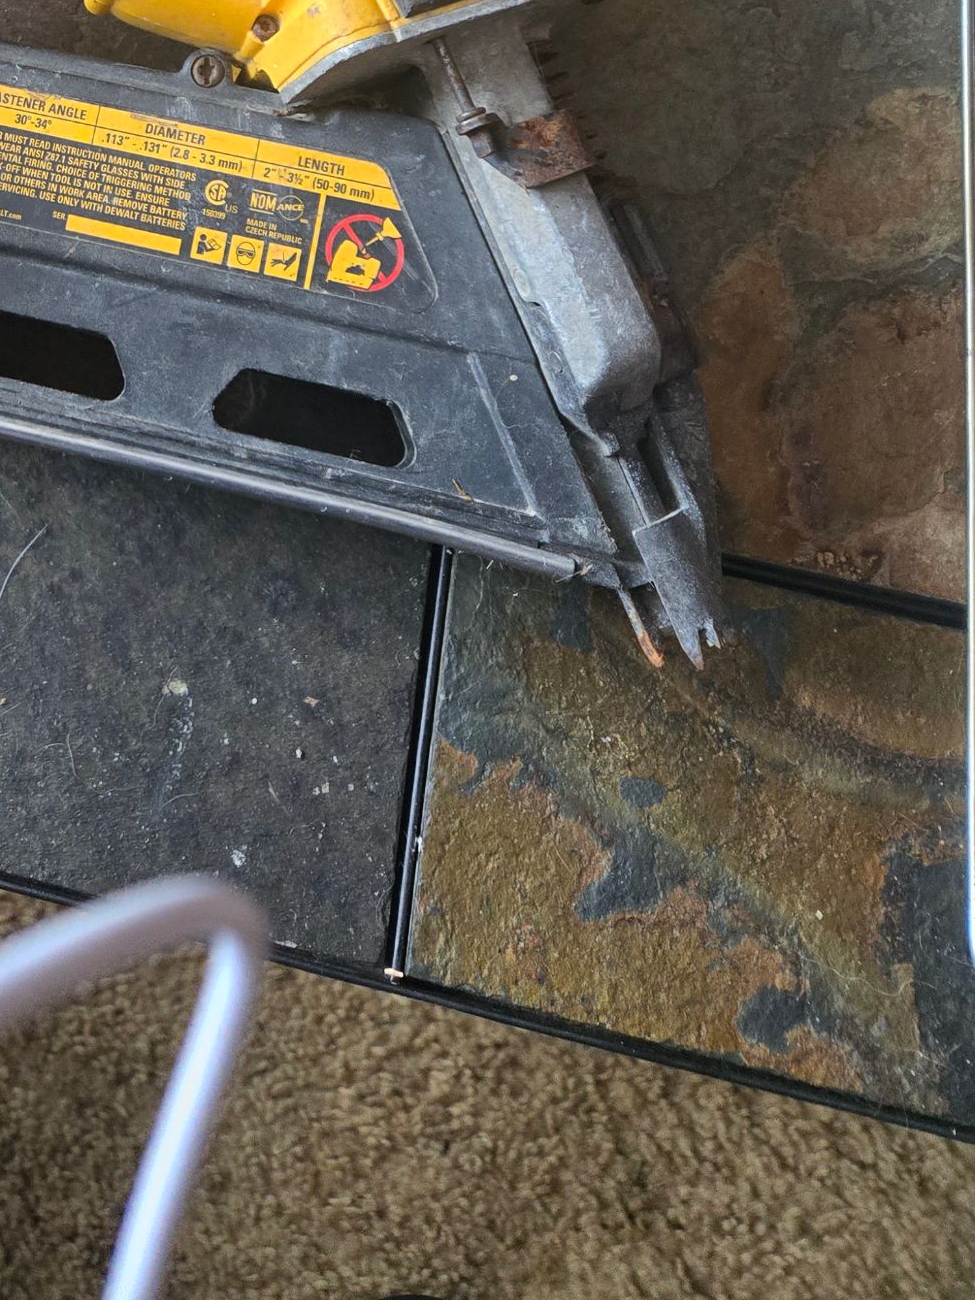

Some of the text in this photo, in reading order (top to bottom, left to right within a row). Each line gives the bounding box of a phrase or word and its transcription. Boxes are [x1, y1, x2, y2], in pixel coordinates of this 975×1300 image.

[48, 103, 87, 120] ANGLE
[145, 123, 206, 146] DIAMETER
[3, 133, 28, 145] MUST
[29, 138, 51, 149] READ
[52, 143, 107, 161] INSTRUCTION
[148, 164, 197, 181] OPERATORS
[22, 147, 44, 158] ANSI
[67, 156, 99, 170] SAFETY
[100, 163, 139, 179] GLASSES
[140, 172, 164, 184] WITH
[165, 177, 186, 189] SIDE
[199, 153, 216, 165] 3.3
[298, 157, 346, 175] LENGTH
[24, 157, 55, 171] FIRING.
[56, 164, 87, 177] CHOICE
[88, 171, 101, 181] OF
[101, 174, 153, 192] TRIGGERING
[0, 173, 13, 182] OR
[13, 175, 46, 189] OTHERS
[47, 183, 57, 192] IN
[59, 185, 85, 198] WORK
[86, 191, 111, 203] AREA.
[112, 197, 148, 212] REMOVE
[22, 167, 49, 179] WHEN
[49, 173, 72, 185] TOOL
[73, 178, 82, 187] IS
[83, 180, 102, 191] NOT
[103, 184, 113, 194] IN
[135, 192, 170, 206] ENSURE
[312, 178, 347, 195] (50-90
[349, 186, 376, 201] mm)
[39, 191, 56, 202] USE
[57, 195, 79, 207] ONLY
[80, 200, 104, 212] WITH
[104, 205, 140, 220] DEWALT
[140, 213, 186, 231] BATTERIES
[249, 193, 277, 211] NOM
[245, 226, 302, 244] CZECH REPUBLIC
[246, 218, 277, 231] MADE IN
